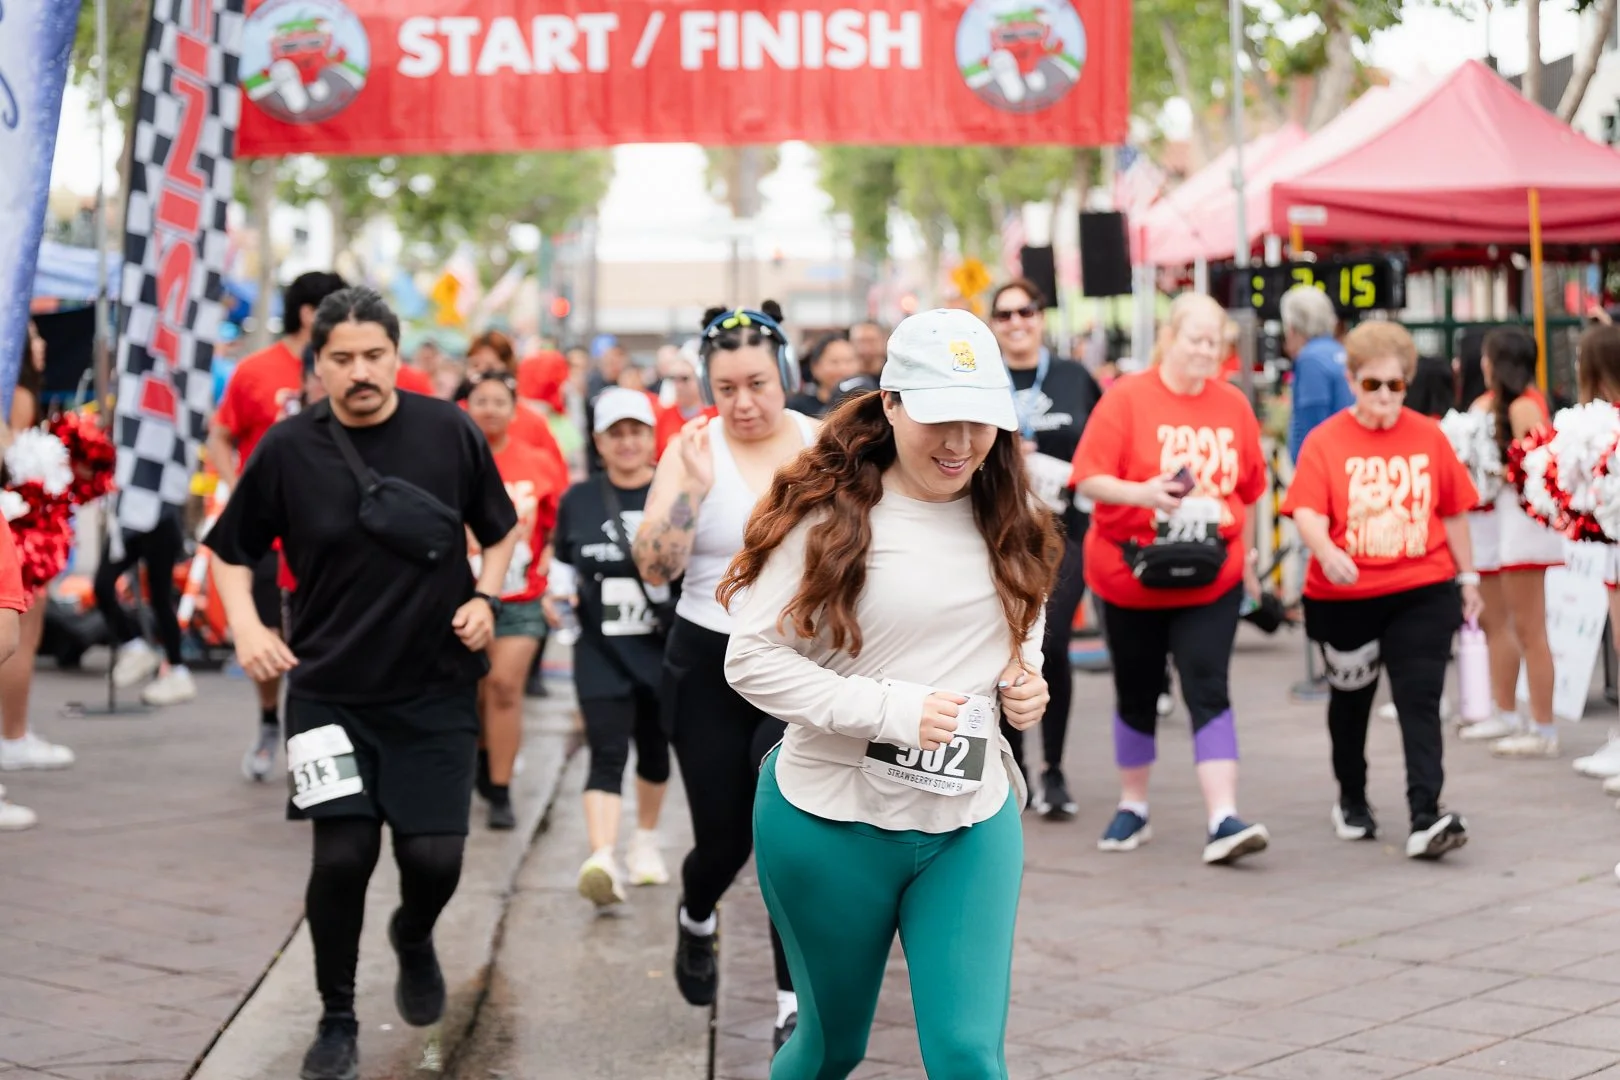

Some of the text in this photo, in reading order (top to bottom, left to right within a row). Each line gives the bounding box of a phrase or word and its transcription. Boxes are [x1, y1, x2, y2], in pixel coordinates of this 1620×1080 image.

[397, 9, 922, 77] START / FINISH
[1157, 424, 1238, 496] 2025
[1345, 453, 1431, 521] 2025
[294, 757, 340, 793] 513
[887, 767, 932, 786] STRAWBERRY
